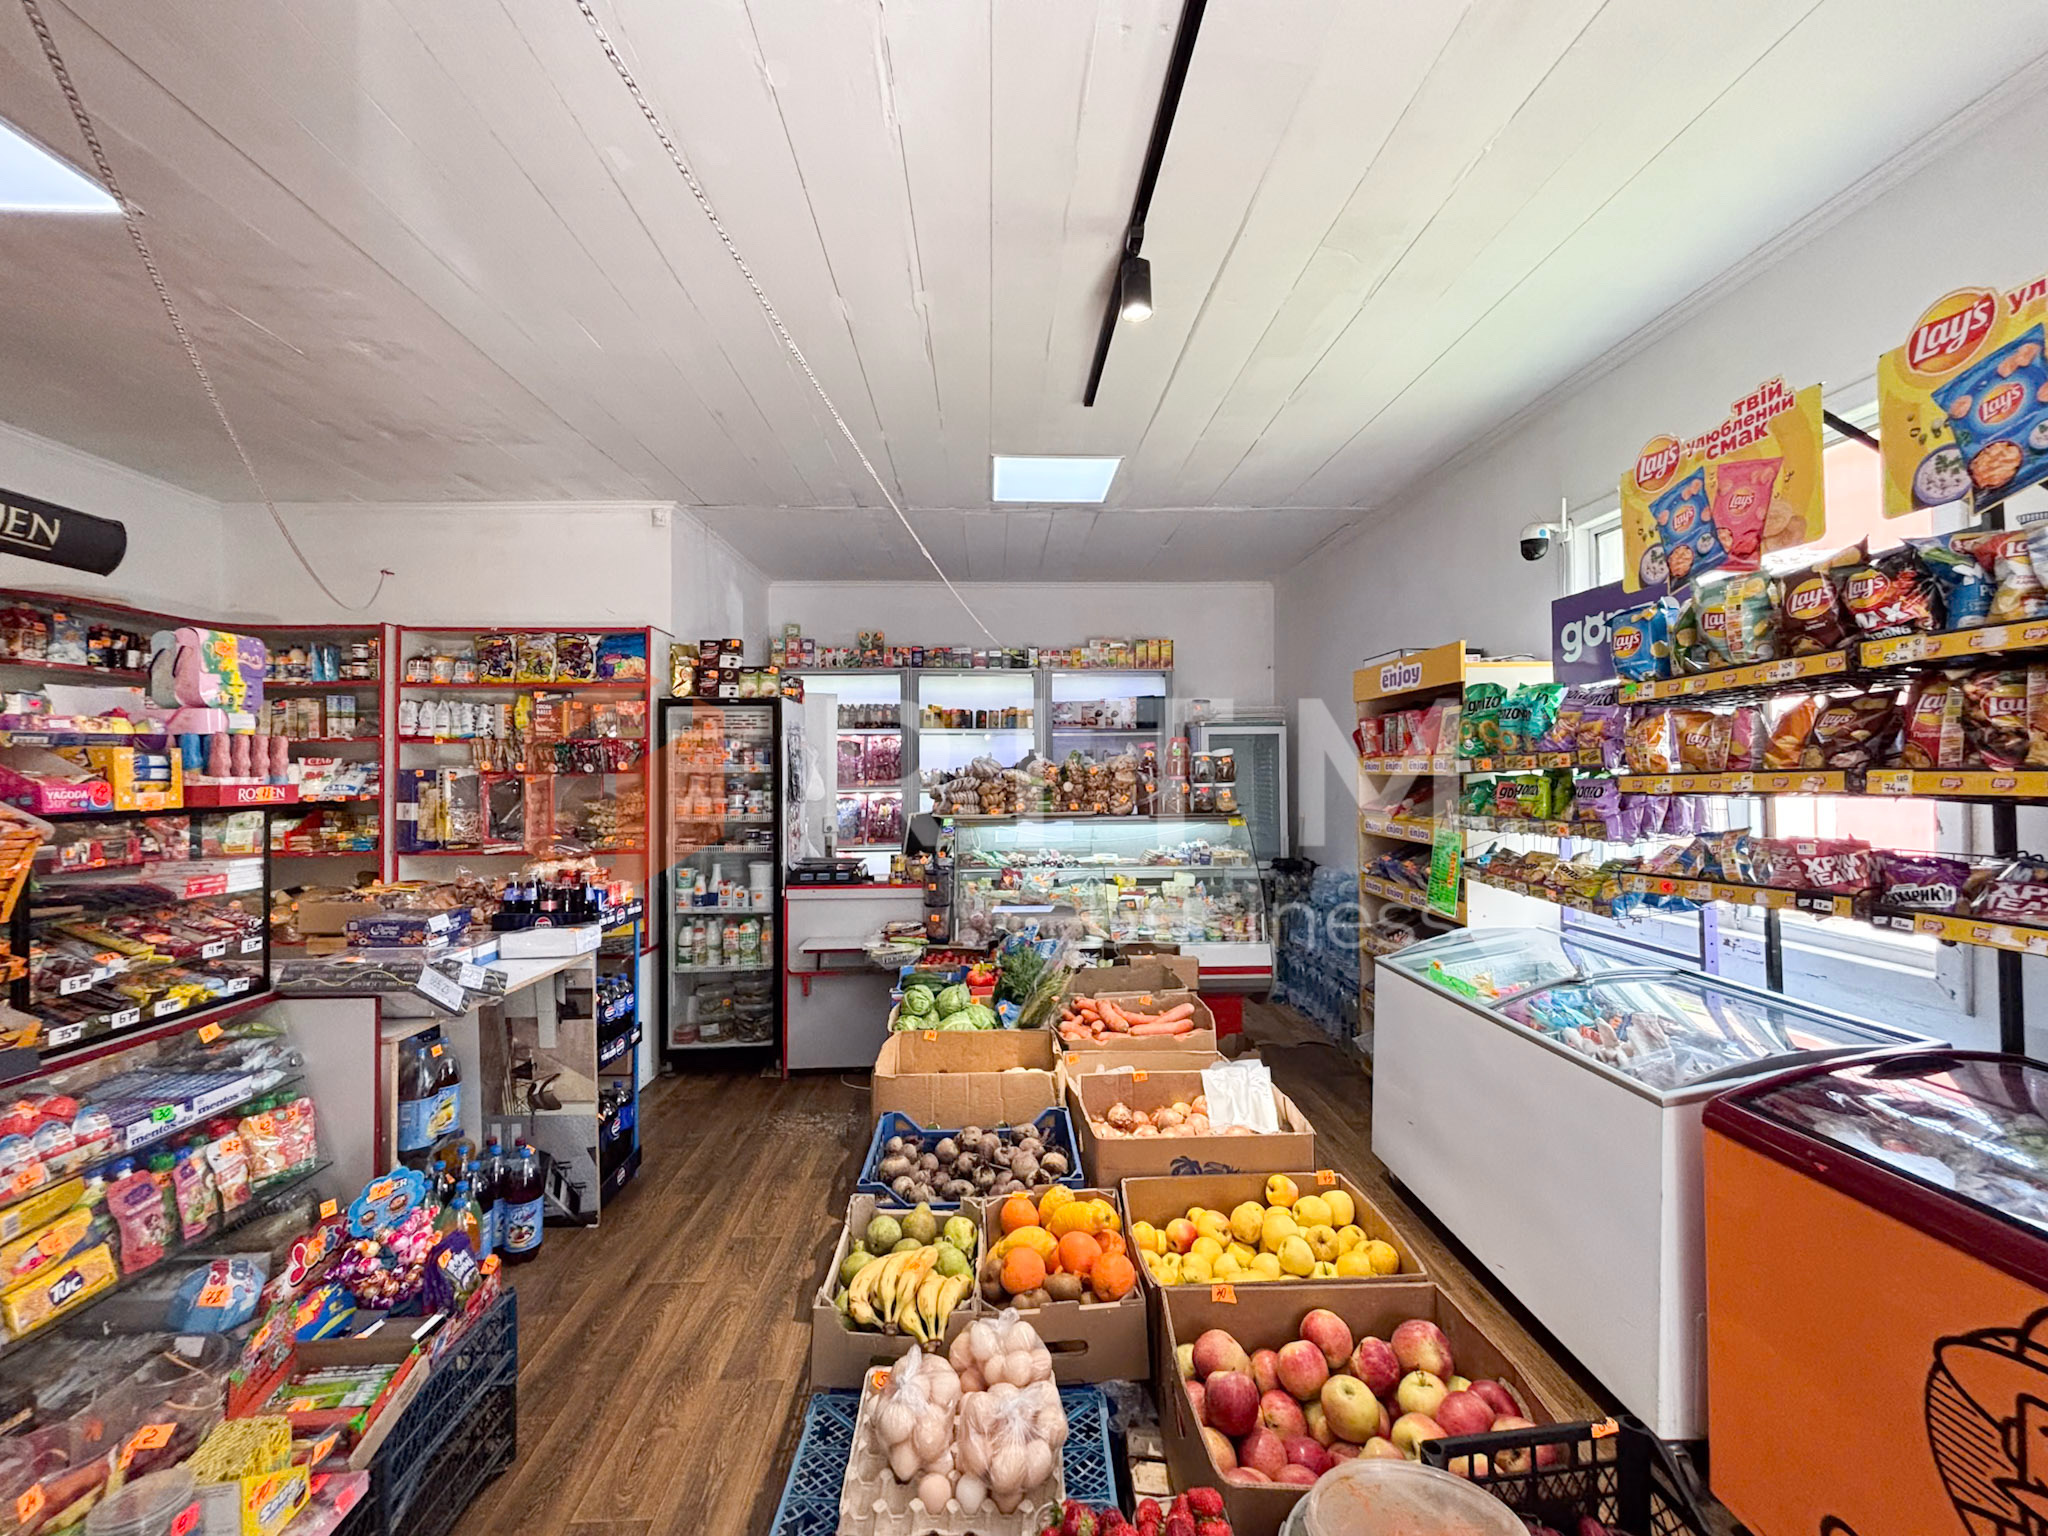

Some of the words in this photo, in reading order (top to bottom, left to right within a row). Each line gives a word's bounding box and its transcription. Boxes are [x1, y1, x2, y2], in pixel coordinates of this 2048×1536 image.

[1912, 297, 1995, 362] Lay's
[1734, 378, 1783, 416] твій
[1979, 384, 2024, 424] Lay's
[1686, 391, 1794, 457] улюблений
[1706, 422, 1768, 460] смак
[1638, 444, 1680, 483] Lay's
[1703, 613, 1726, 630] Lay
[1613, 632, 1641, 650] Lay's
[1382, 665, 1420, 689] enjoy
[1915, 694, 1949, 715] Lay
[1989, 697, 2027, 718] Lay
[1686, 733, 1710, 747] Lay
[238, 786, 285, 802] ROSEN
[1987, 894, 2048, 911] TEA
[198, 1092, 240, 1114] mentos
[131, 1121, 178, 1146] mentos
